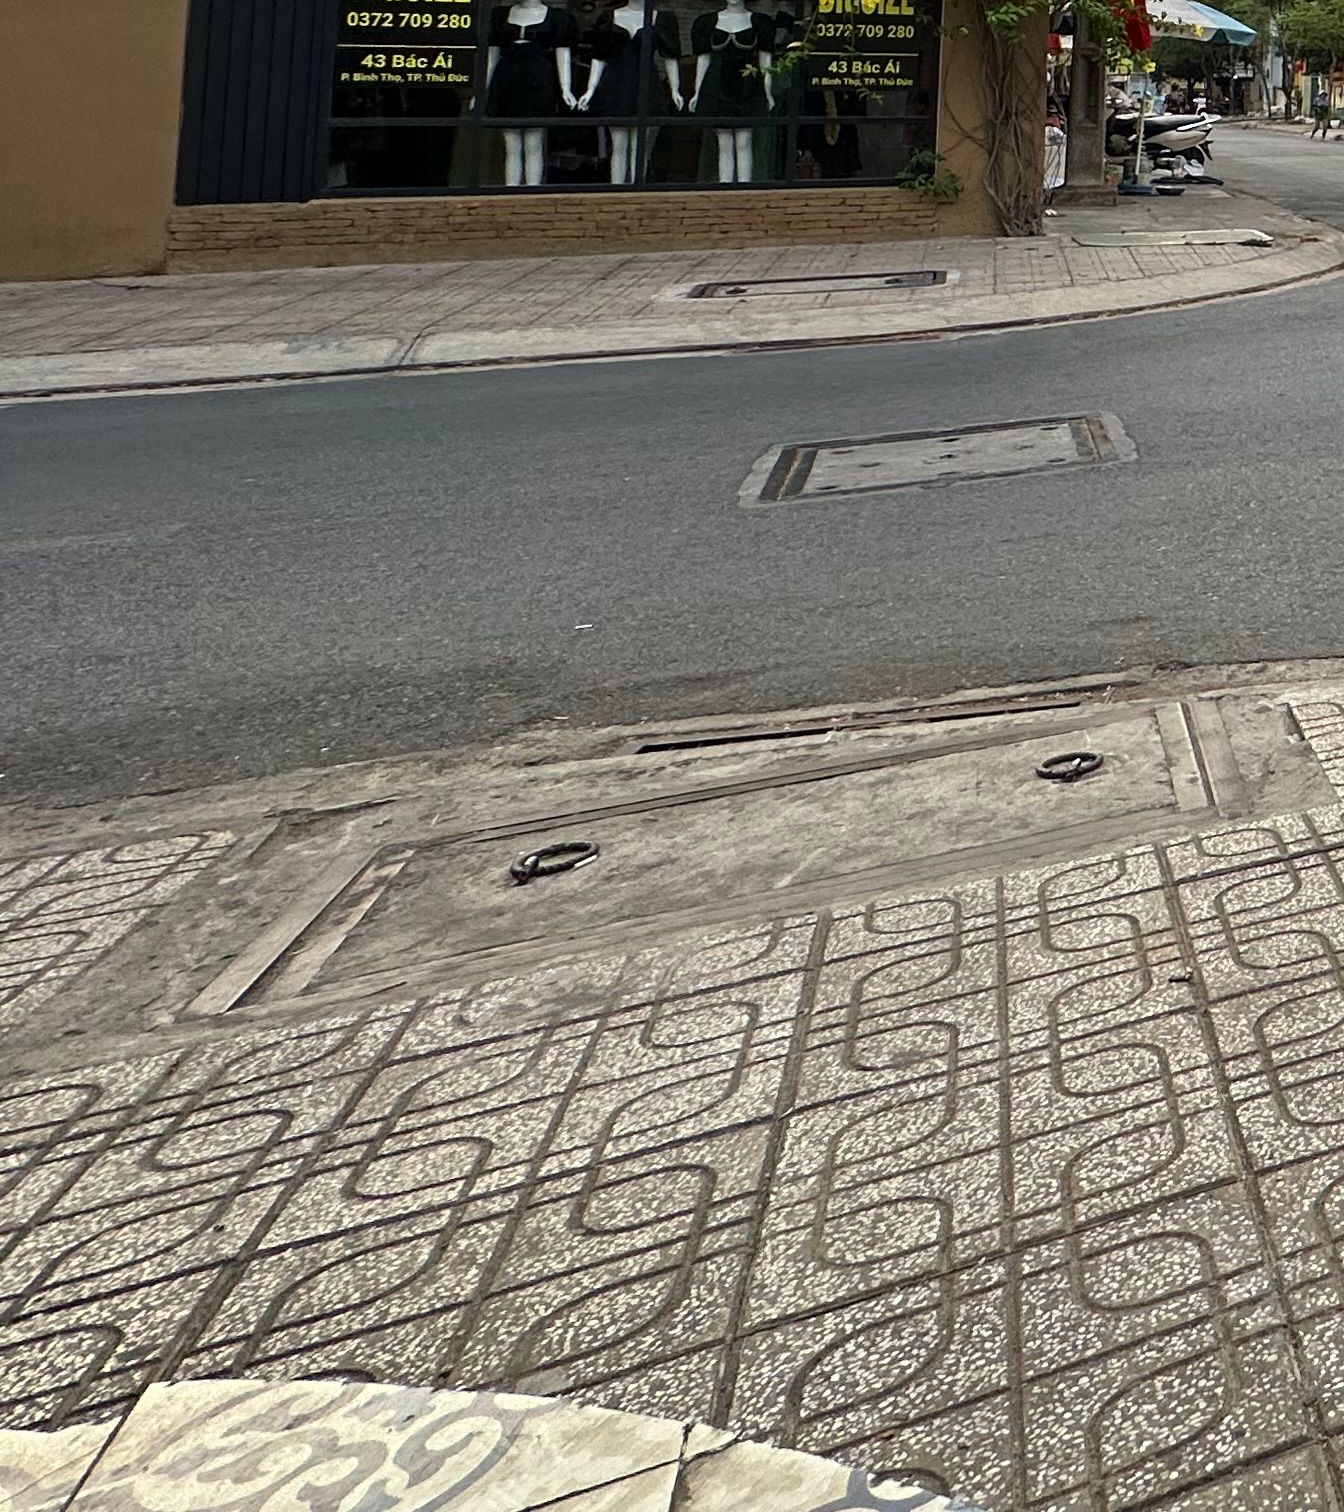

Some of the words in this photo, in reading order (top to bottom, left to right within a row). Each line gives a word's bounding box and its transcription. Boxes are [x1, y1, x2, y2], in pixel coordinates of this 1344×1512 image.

[347, 11, 393, 27] 0372
[398, 12, 433, 28] 709
[437, 14, 471, 28] 280
[857, 24, 884, 38] 709
[888, 26, 915, 39] 280
[361, 54, 386, 68] 43
[392, 53, 428, 68] Bác
[433, 51, 453, 68] Ái
[828, 61, 847, 74] 43
[852, 60, 880, 74] Bác
[884, 58, 900, 74] Ái
